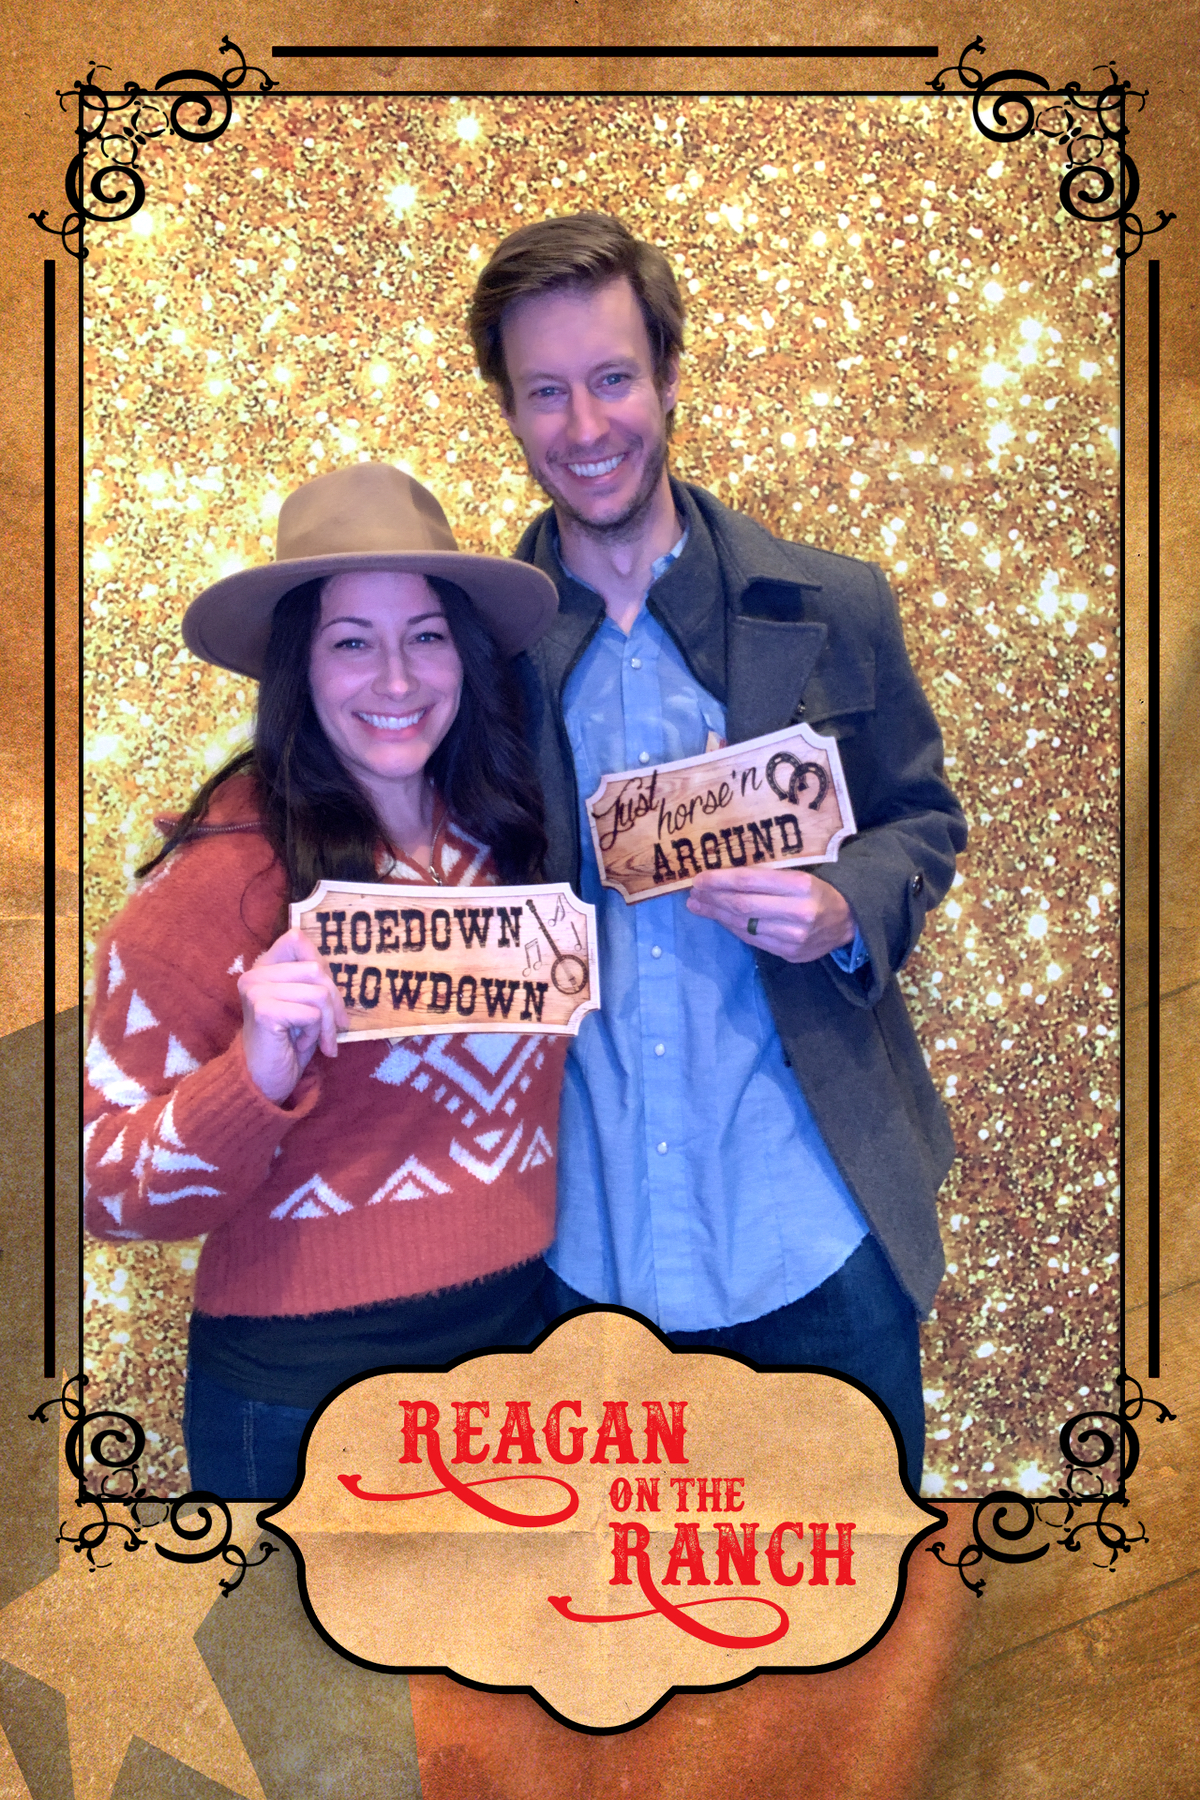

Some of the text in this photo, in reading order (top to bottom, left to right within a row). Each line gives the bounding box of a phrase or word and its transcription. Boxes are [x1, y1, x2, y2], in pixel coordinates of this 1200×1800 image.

[653, 814, 803, 883] AROUND
[316, 906, 523, 955] HOEDOWN
[329, 962, 548, 1021] HOWDOWN
